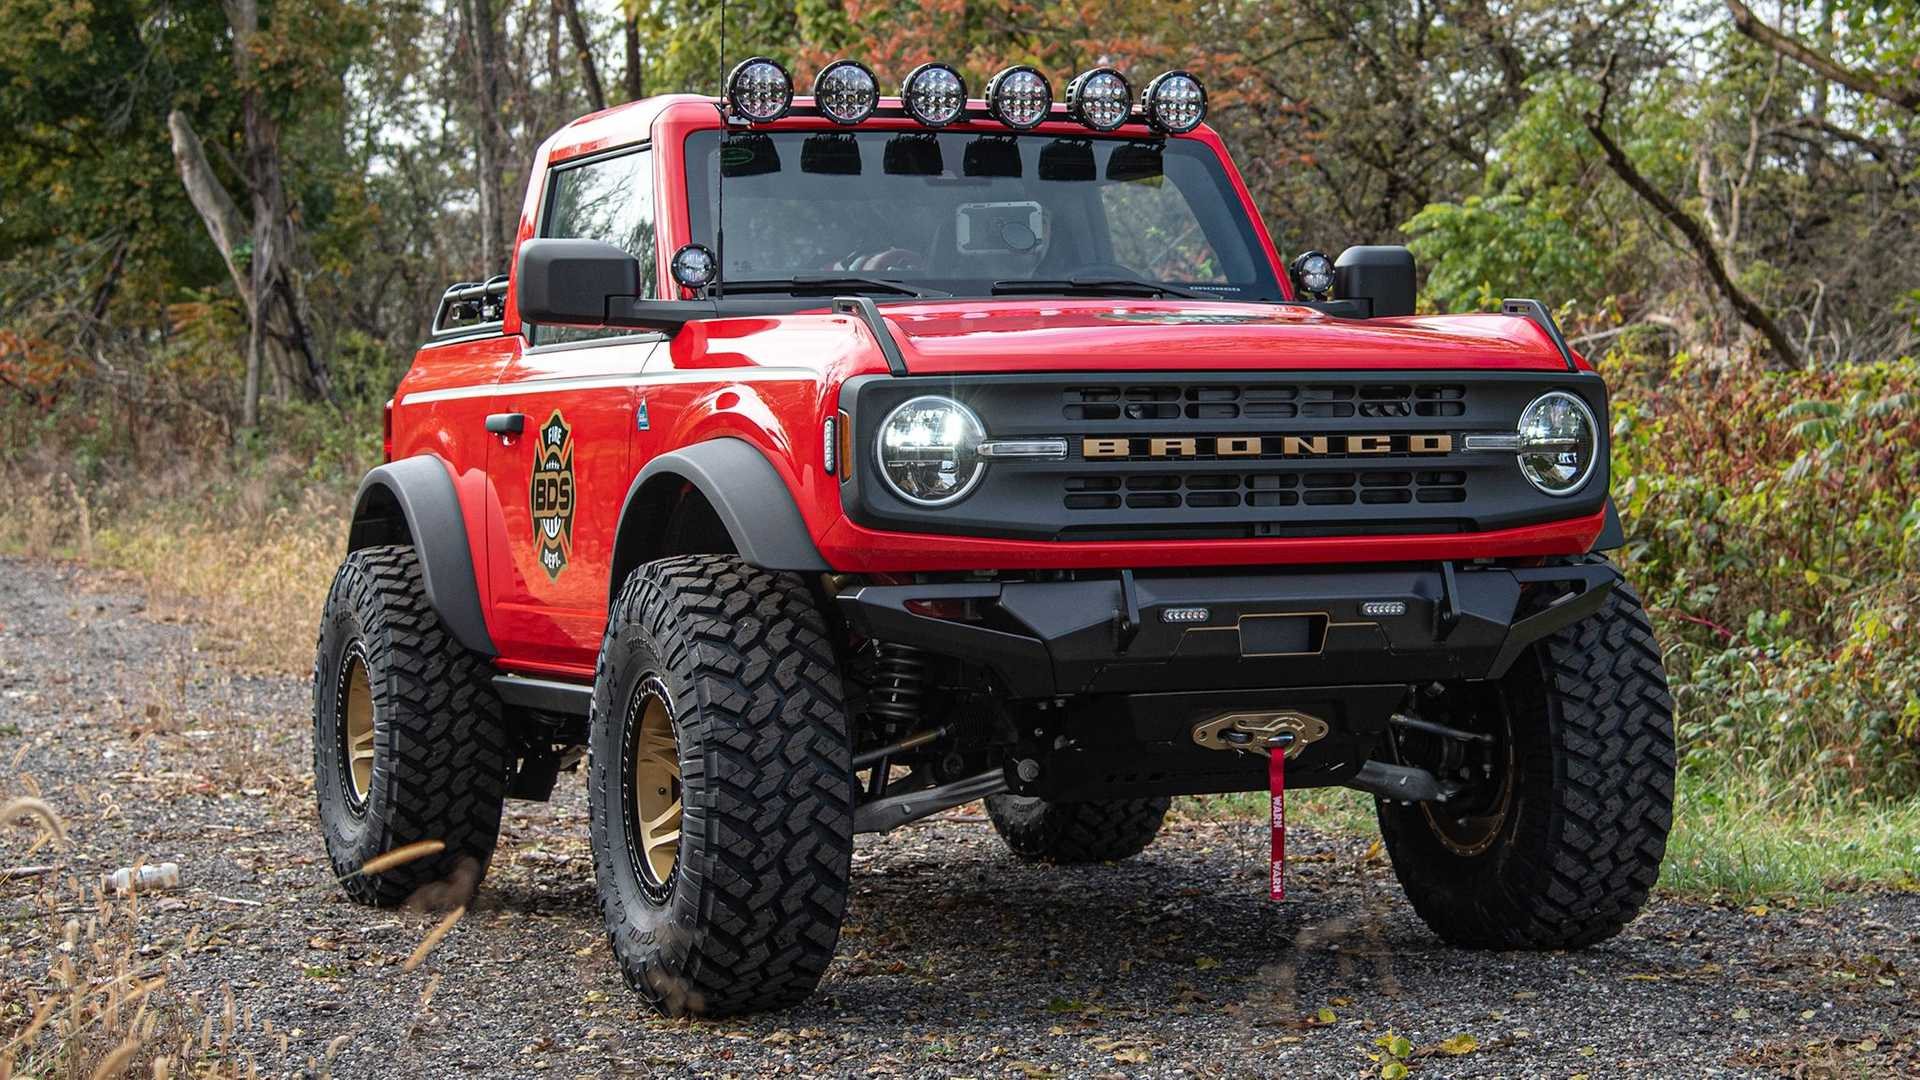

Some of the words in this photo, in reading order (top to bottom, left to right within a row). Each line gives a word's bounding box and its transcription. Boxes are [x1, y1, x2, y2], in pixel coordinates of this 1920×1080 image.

[547, 425, 562, 445] FIRE
[1083, 436, 1452, 458] BRONCO
[534, 473, 572, 517] BDS
[1273, 796, 1282, 828] WARN
[1273, 861, 1282, 892] WARN
